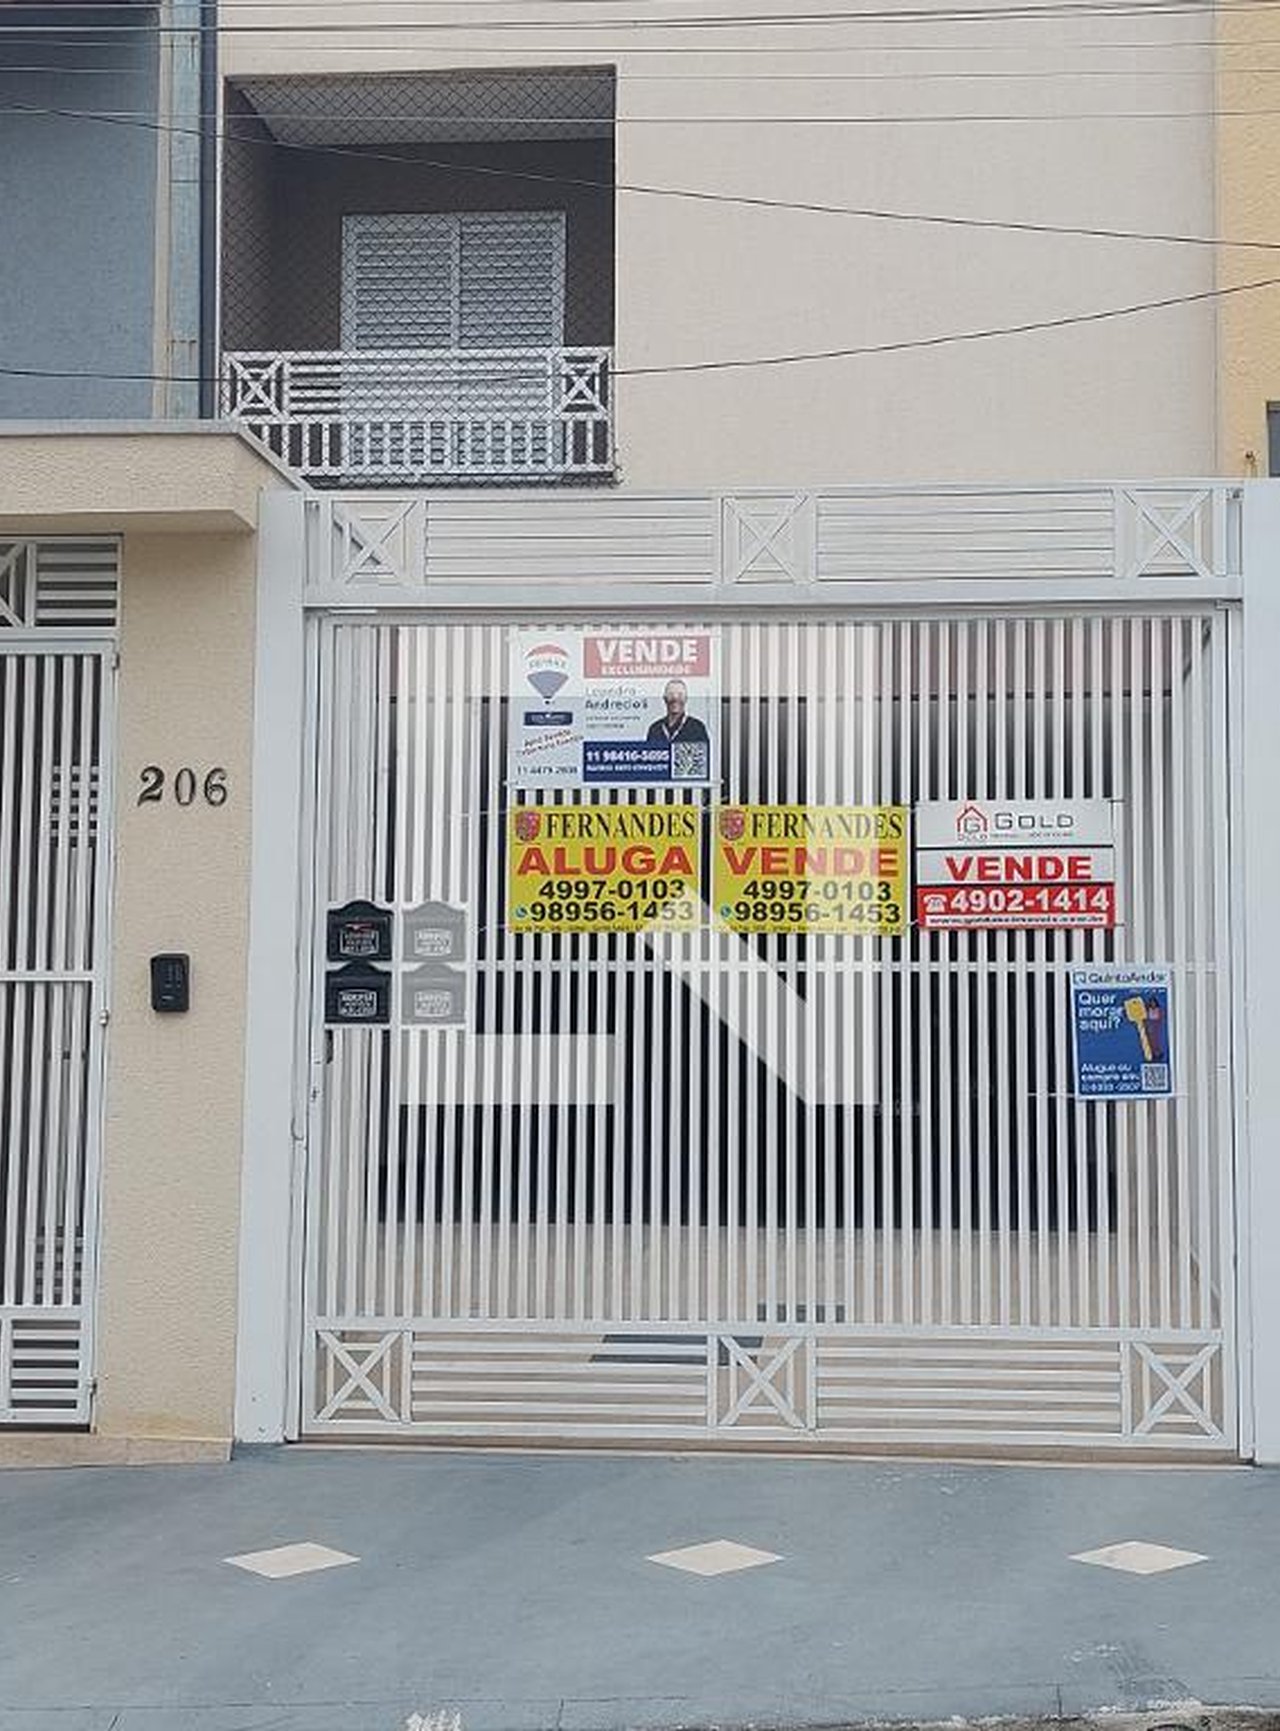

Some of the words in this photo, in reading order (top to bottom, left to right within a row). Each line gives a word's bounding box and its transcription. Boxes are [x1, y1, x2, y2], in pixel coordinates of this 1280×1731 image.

[596, 639, 699, 663] VENDE
[136, 766, 228, 807] 206
[546, 812, 695, 839] FERNANDES
[751, 812, 902, 839] FERNANDES
[517, 845, 693, 876] ALUGA
[723, 846, 900, 877] VENDE
[945, 855, 1092, 881] VENDE
[539, 879, 686, 900] 4997-0103
[743, 880, 892, 901] 4997-0103
[950, 888, 1110, 912] 4902-1414
[531, 901, 694, 922] 98956-1453
[735, 901, 901, 923] 98956-1453
[1079, 992, 1116, 1006] Quer
[1079, 1016, 1121, 1032] aqui?
